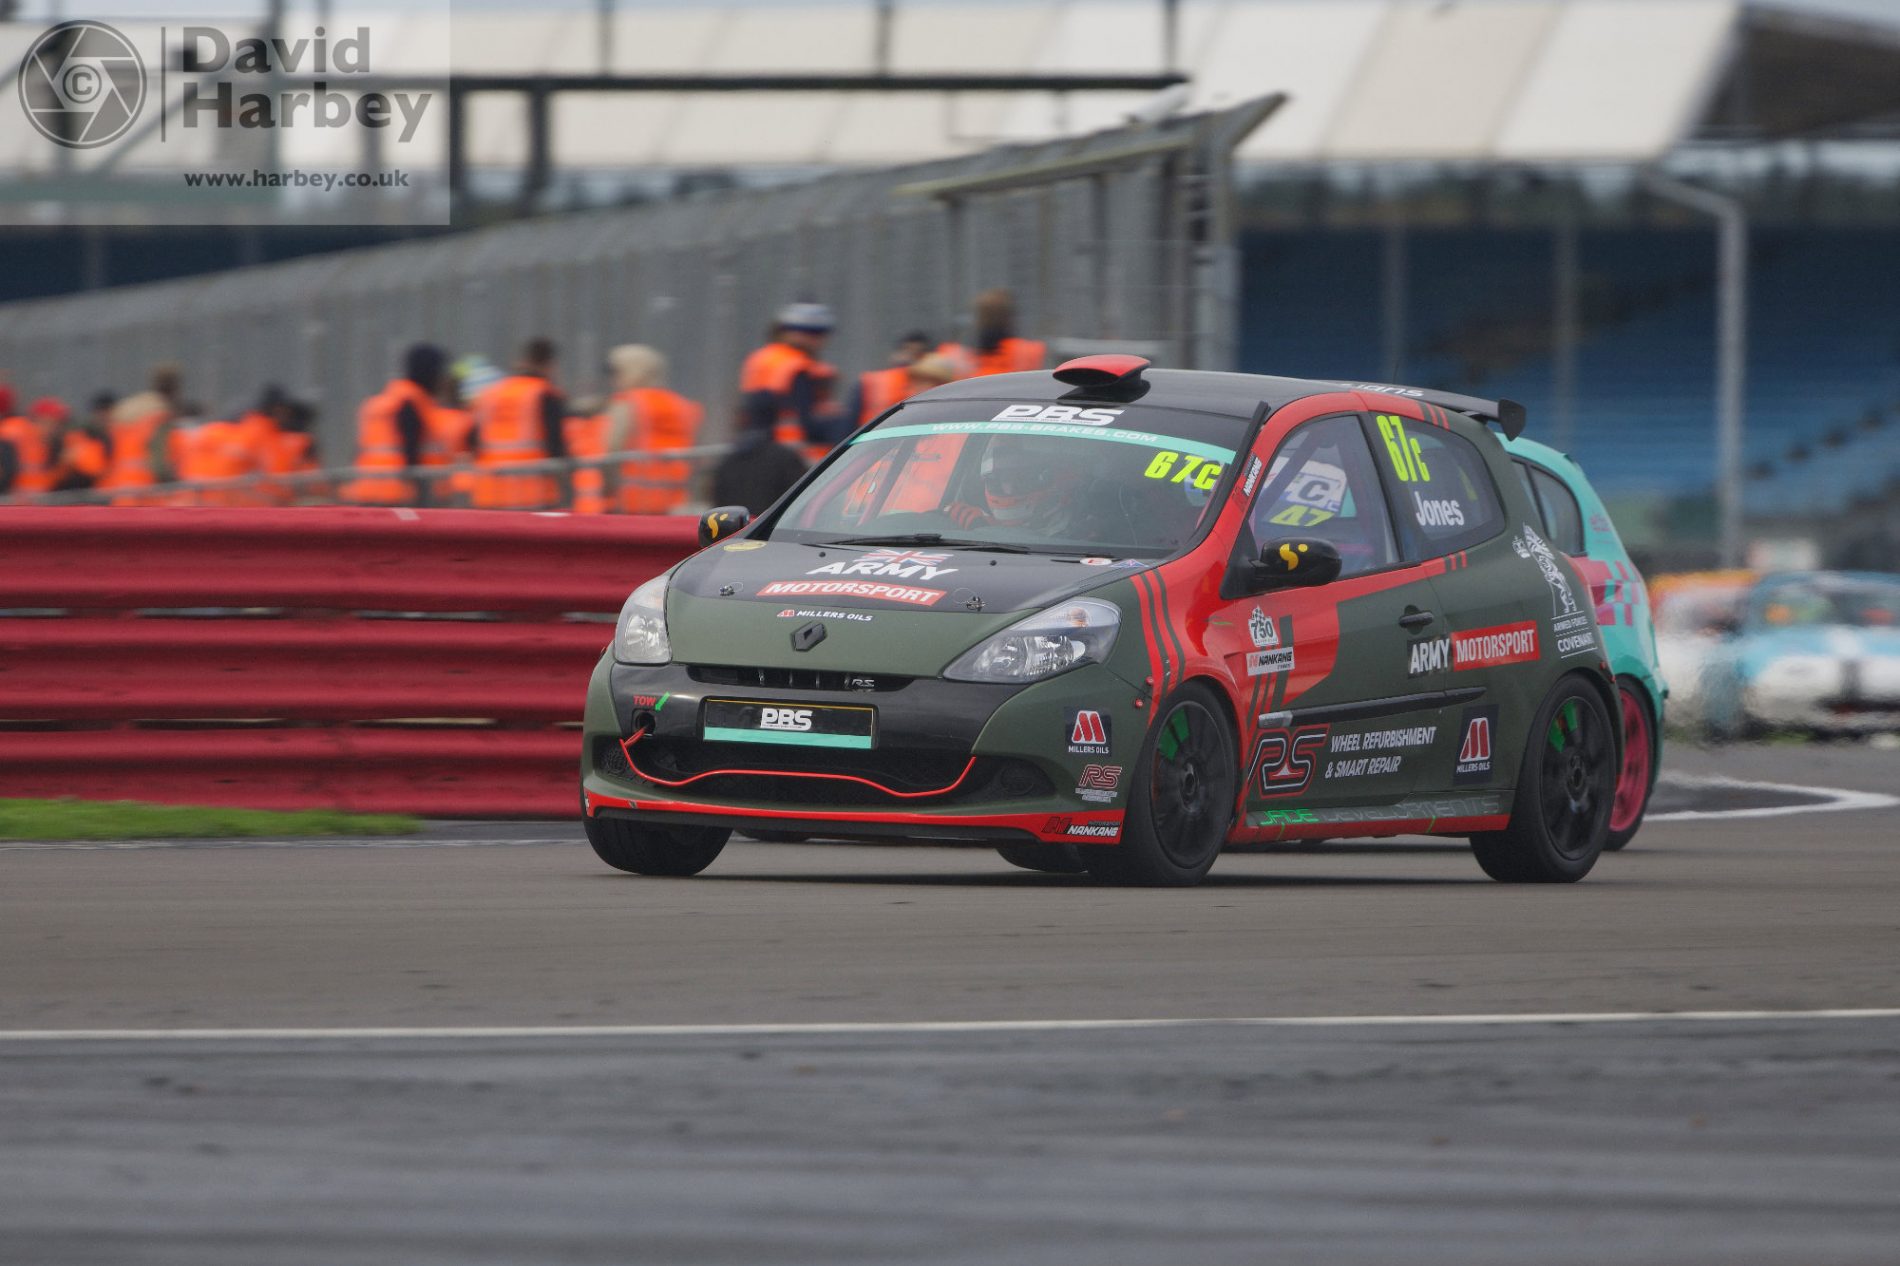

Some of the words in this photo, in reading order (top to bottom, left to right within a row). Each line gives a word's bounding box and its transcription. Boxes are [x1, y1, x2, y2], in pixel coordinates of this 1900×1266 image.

[990, 405, 1126, 426] PBS
[1415, 491, 1465, 527] Jones
[806, 562, 958, 580] ARMY
[768, 581, 939, 603] MOTORSPORT
[796, 610, 846, 619] MILLERS
[848, 613, 873, 622] OILS
[1251, 620, 1274, 639] 750
[1259, 652, 1293, 666] NANKANG
[1410, 638, 1450, 674] ARMY
[1455, 629, 1534, 663] MOTORSPORT
[634, 695, 657, 707] TOW
[760, 707, 813, 731] PBS
[1331, 732, 1360, 752] WHEEL
[1363, 726, 1437, 750] REFURBISHMENT
[1068, 745, 1095, 754] MILLERS
[1096, 746, 1109, 755] OILS
[1246, 723, 1331, 799] RS
[1325, 762, 1333, 779] &
[1336, 757, 1367, 778] SMART
[1367, 756, 1402, 774] REPAIR
[1456, 763, 1476, 773] MILLERS
[1477, 761, 1491, 771] OILS
[1079, 764, 1122, 789] RS
[1067, 825, 1119, 837] NANKANG
